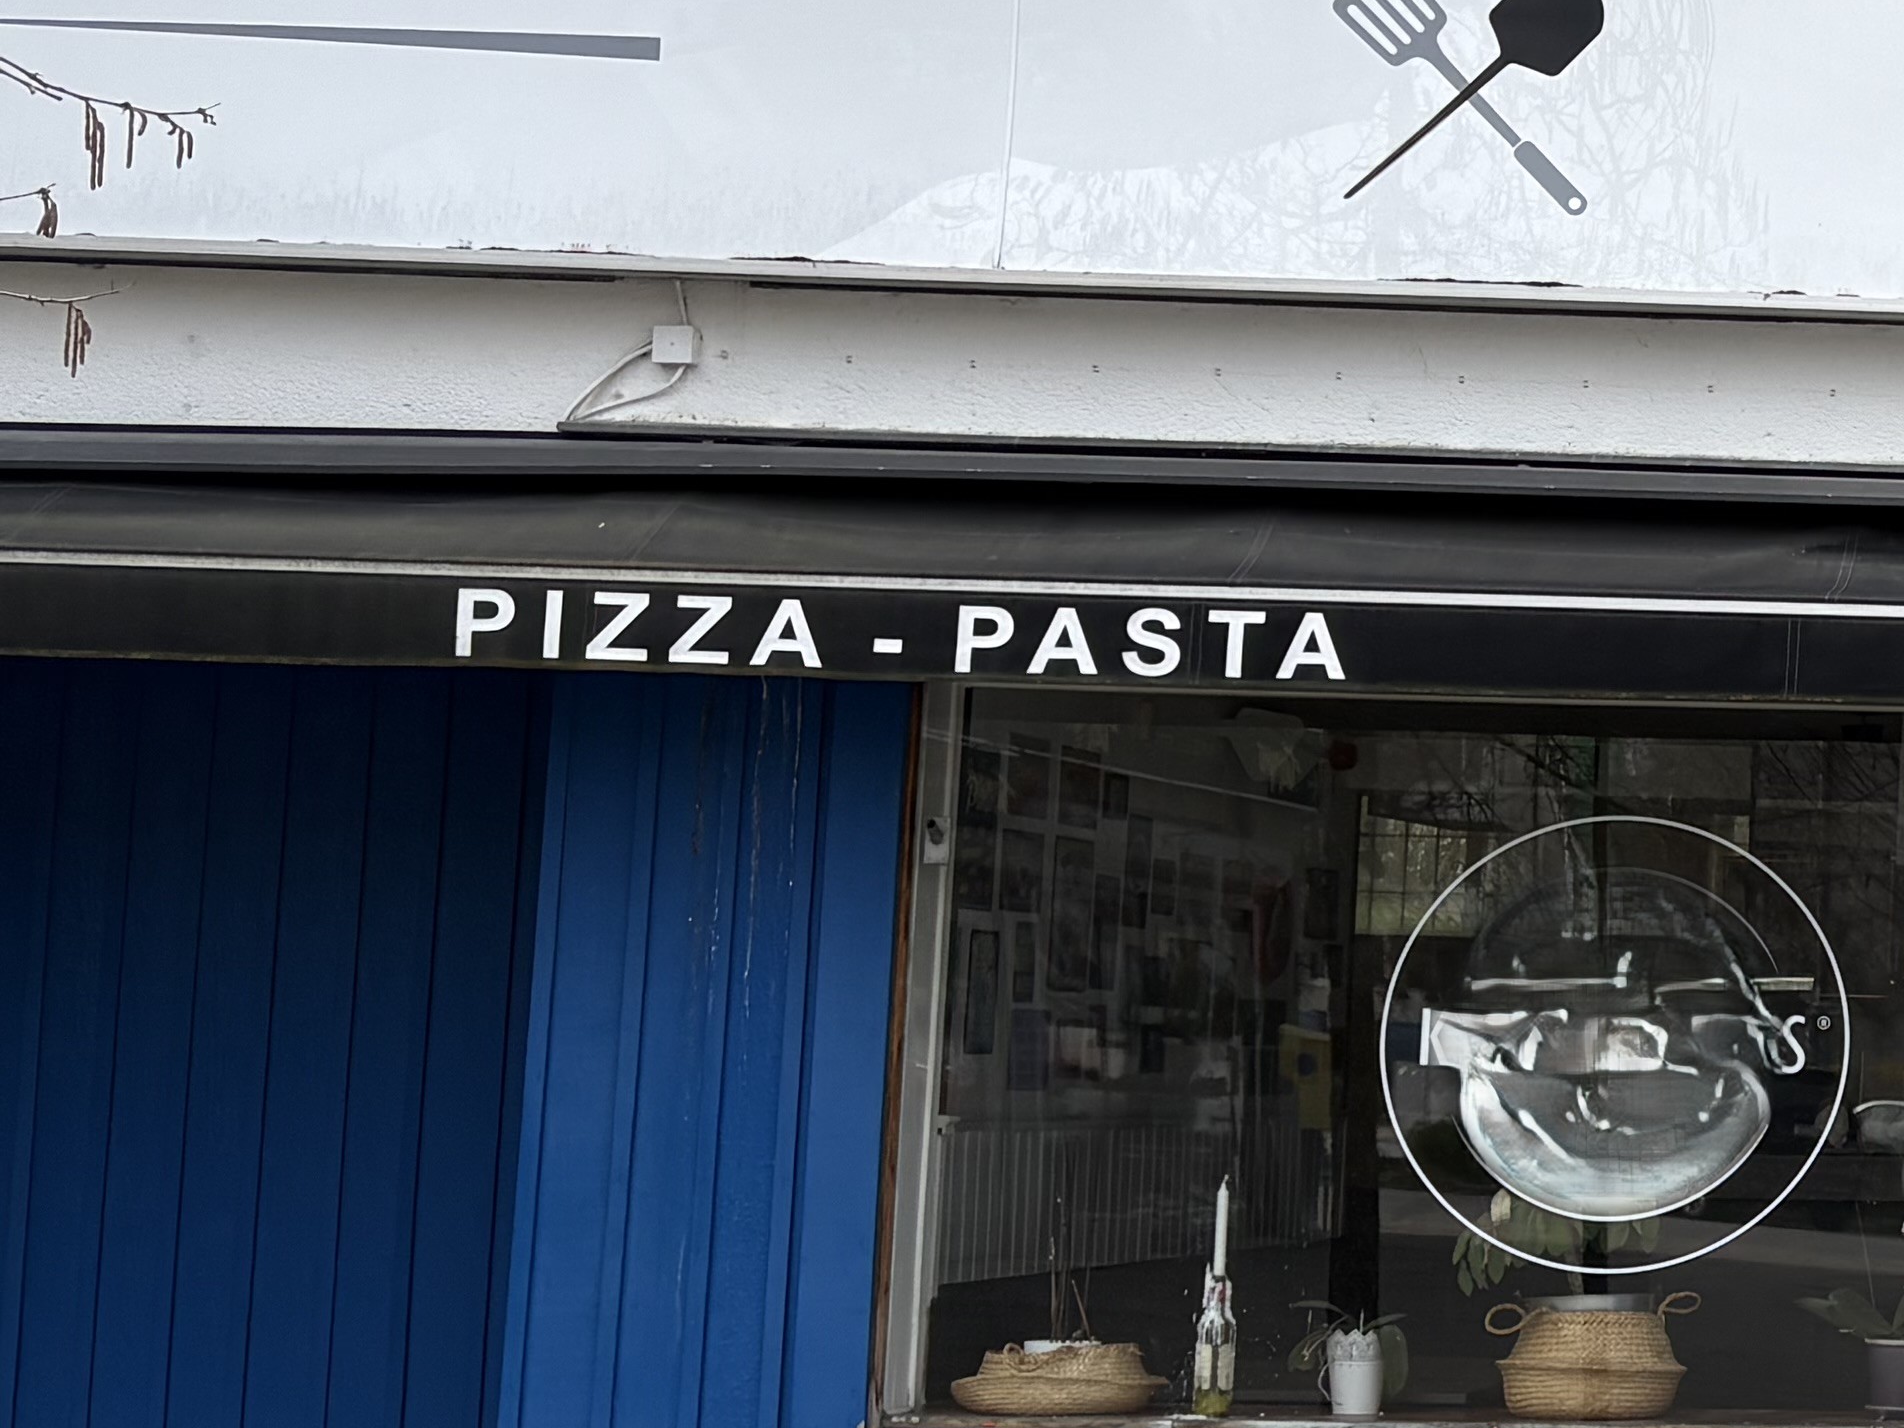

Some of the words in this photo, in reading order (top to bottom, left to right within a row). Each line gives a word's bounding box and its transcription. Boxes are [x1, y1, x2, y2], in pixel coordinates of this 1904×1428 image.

[455, 587, 823, 669] PIZZA
[872, 638, 904, 654] -
[953, 604, 1347, 681] PASTA
